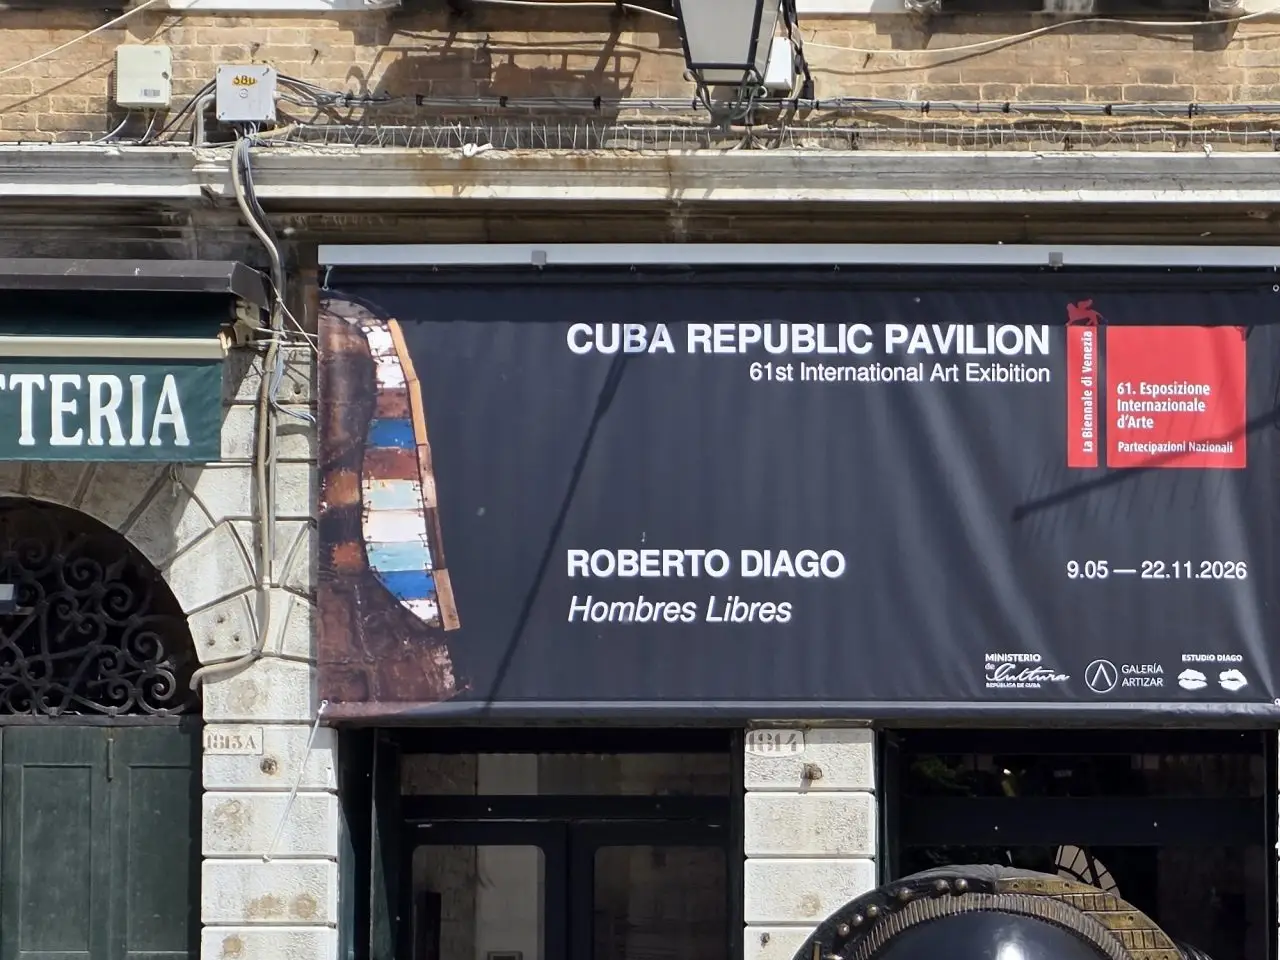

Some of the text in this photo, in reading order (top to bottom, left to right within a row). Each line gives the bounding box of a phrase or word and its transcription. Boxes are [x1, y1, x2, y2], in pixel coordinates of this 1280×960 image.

[567, 323, 1050, 355] CUBA REPUBLIC PAVILION
[749, 362, 1051, 383] 61st International Art Exibition
[1081, 330, 1093, 452] La Biennale di Venezia
[1117, 382, 1211, 398] 61. Esposizione
[0, 374, 190, 446] TERIA
[1117, 398, 1206, 412] Internazionale
[1118, 441, 1233, 455] Partecipazioni Nazionali
[567, 549, 846, 578] ROBERTO DIAGO
[1066, 560, 1109, 579] 9.05
[1141, 560, 1248, 580] 22.11.2026
[568, 595, 793, 623] Hombres Libres
[985, 653, 1042, 662] MINISTERIO
[1181, 654, 1243, 662] ESTUDIO DIAGO
[1121, 663, 1164, 674] GALERÍA
[1121, 677, 1164, 688] ARTIZAR
[748, 732, 797, 752] 1814
